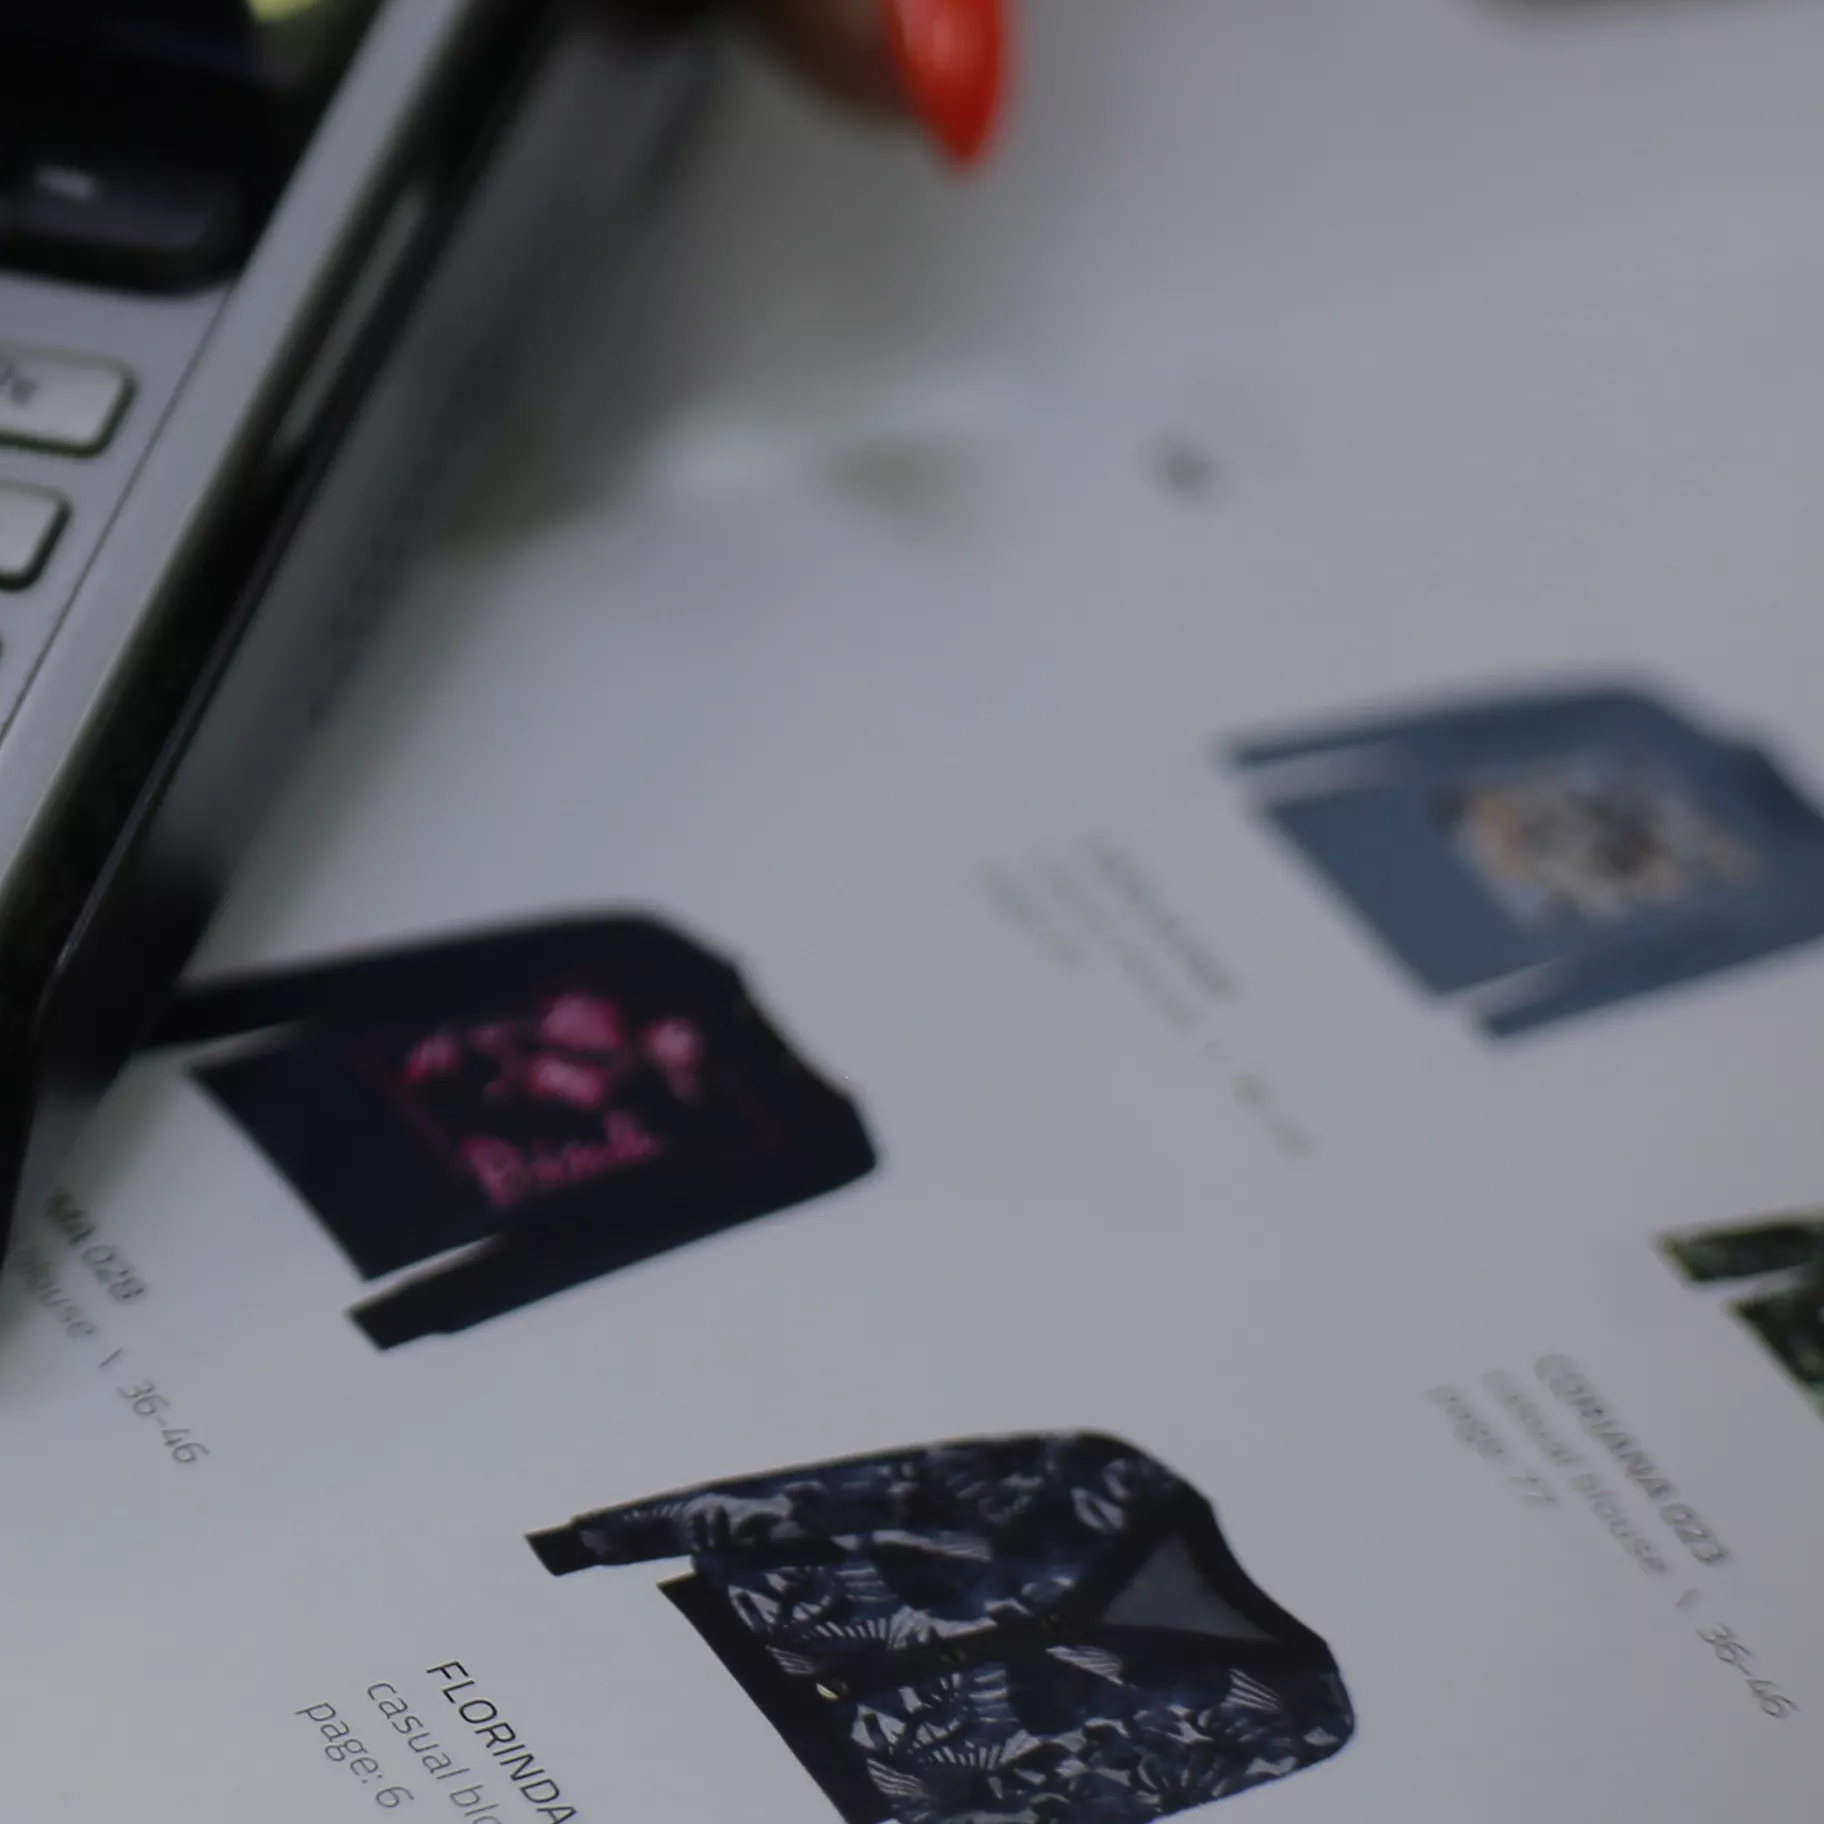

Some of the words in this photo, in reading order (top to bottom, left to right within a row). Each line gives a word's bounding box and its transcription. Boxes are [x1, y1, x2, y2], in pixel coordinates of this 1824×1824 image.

[116, 1378, 211, 1464] 36-46
[1695, 1620, 1801, 1721] 36-46
[294, 1701, 384, 1785] page:
[374, 1784, 415, 1809] 6
[367, 1681, 471, 1780] casual
[425, 1659, 578, 1824] FLORINDA
